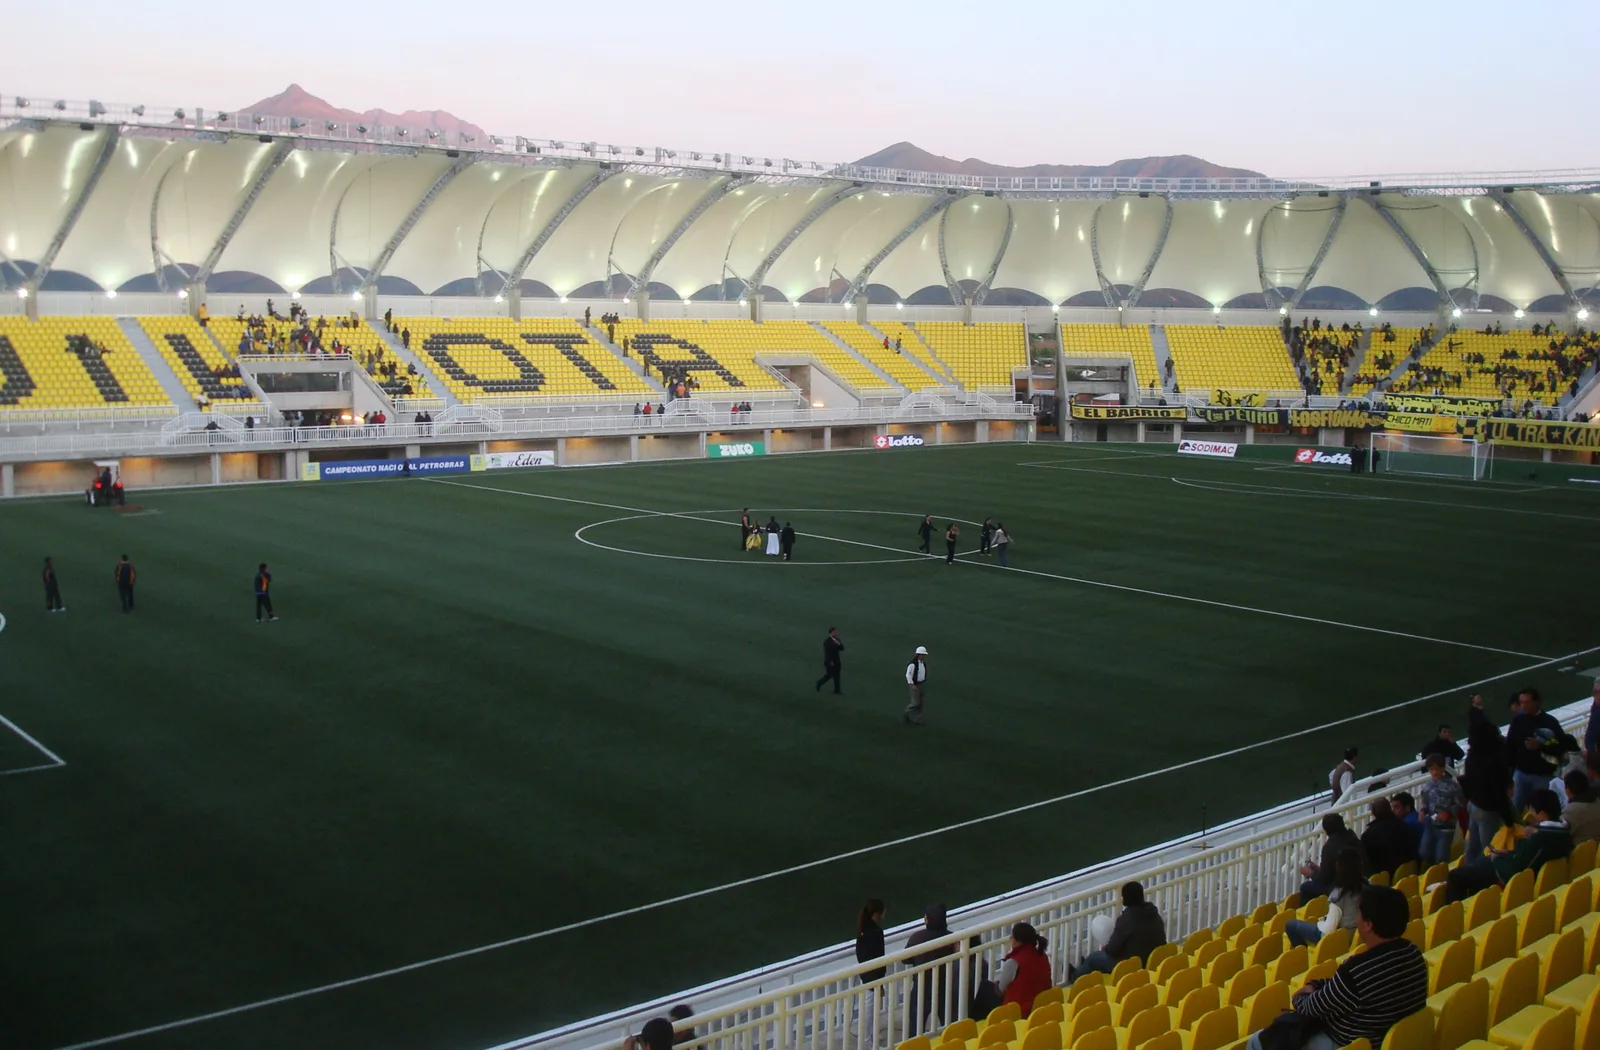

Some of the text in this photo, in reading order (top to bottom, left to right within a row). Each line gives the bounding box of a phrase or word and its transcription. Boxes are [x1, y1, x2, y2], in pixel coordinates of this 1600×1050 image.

[1084, 408, 1171, 418] EL BARRIO
[1492, 422, 1548, 443] ULTRA
[887, 435, 924, 447] lotto
[719, 443, 754, 456] ZUKO
[1190, 443, 1234, 454] SODIMAC
[514, 453, 542, 466] Eden
[325, 465, 377, 474] CAMPEONATO
[378, 463, 417, 471] NACIOAL
[419, 461, 465, 469] PETROBRAS
